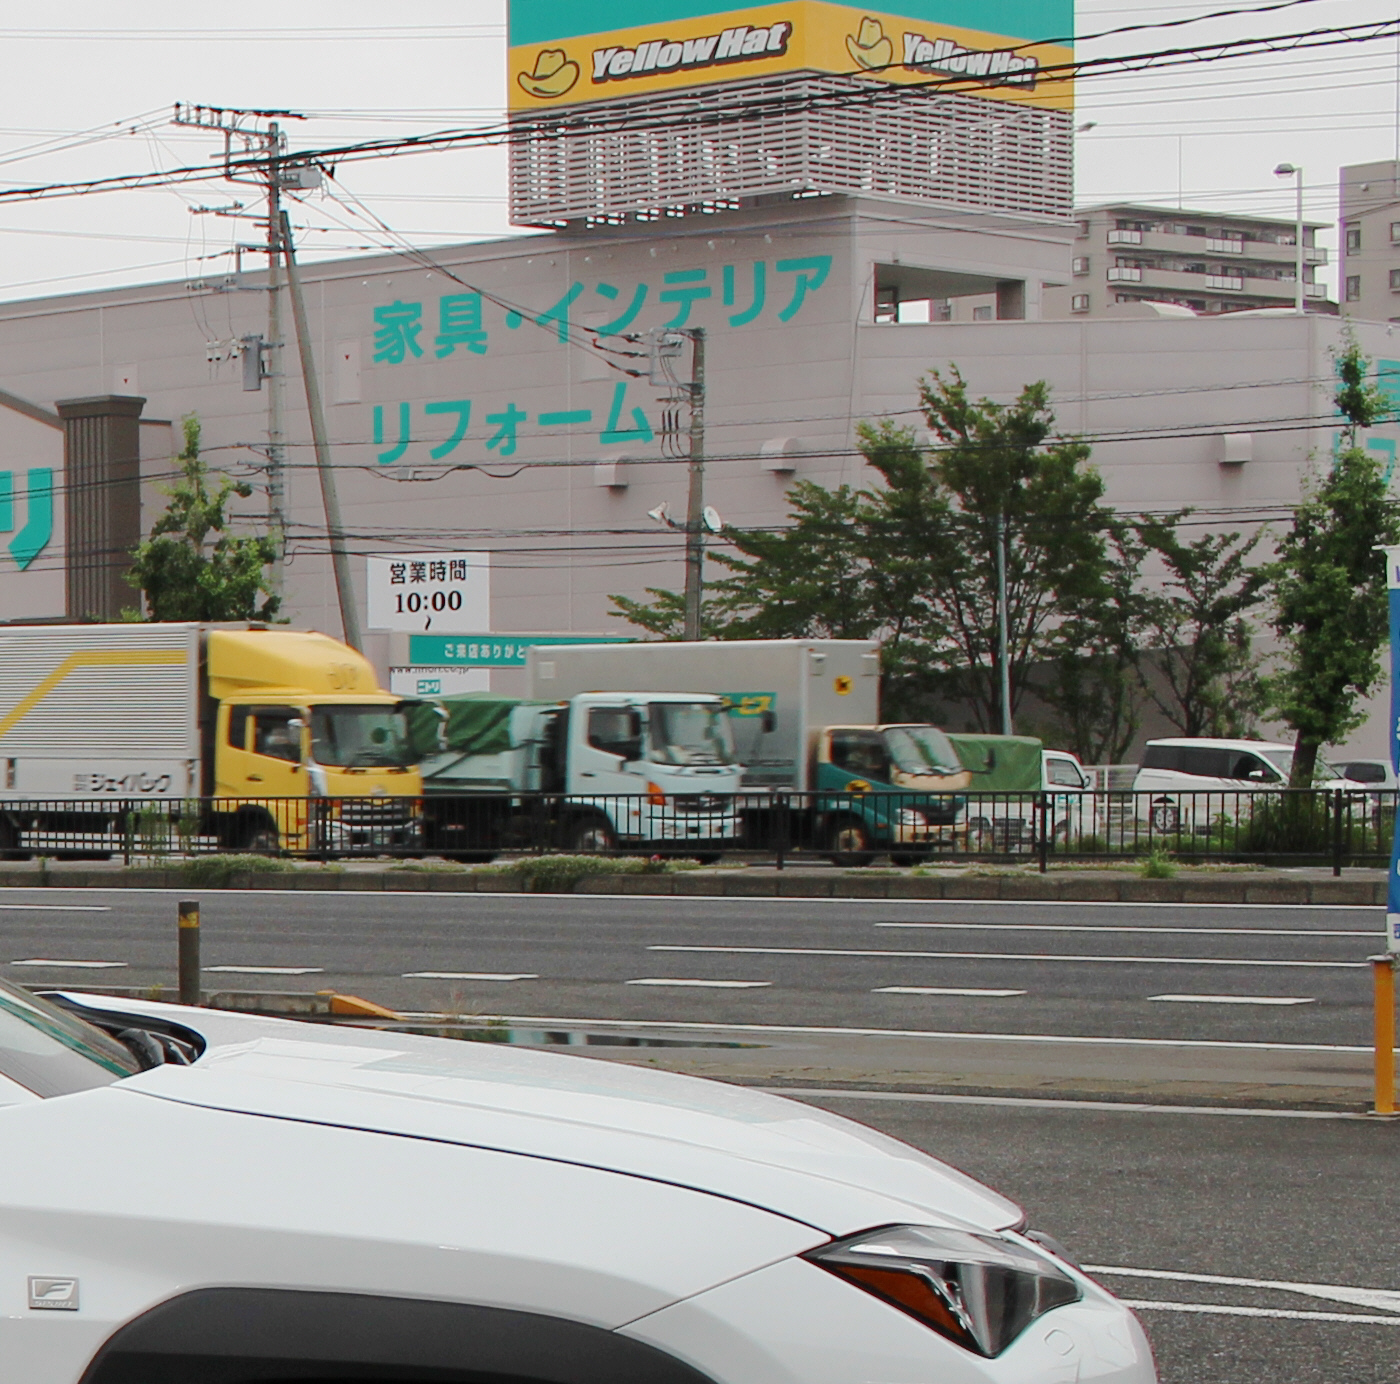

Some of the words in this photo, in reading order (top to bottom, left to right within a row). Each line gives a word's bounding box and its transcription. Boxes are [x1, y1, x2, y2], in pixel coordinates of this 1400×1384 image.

[371, 254, 834, 366] 家具・インテリア
[371, 381, 655, 465] リフォーム
[389, 559, 467, 585] 営業時間
[395, 590, 462, 614] 10:00
